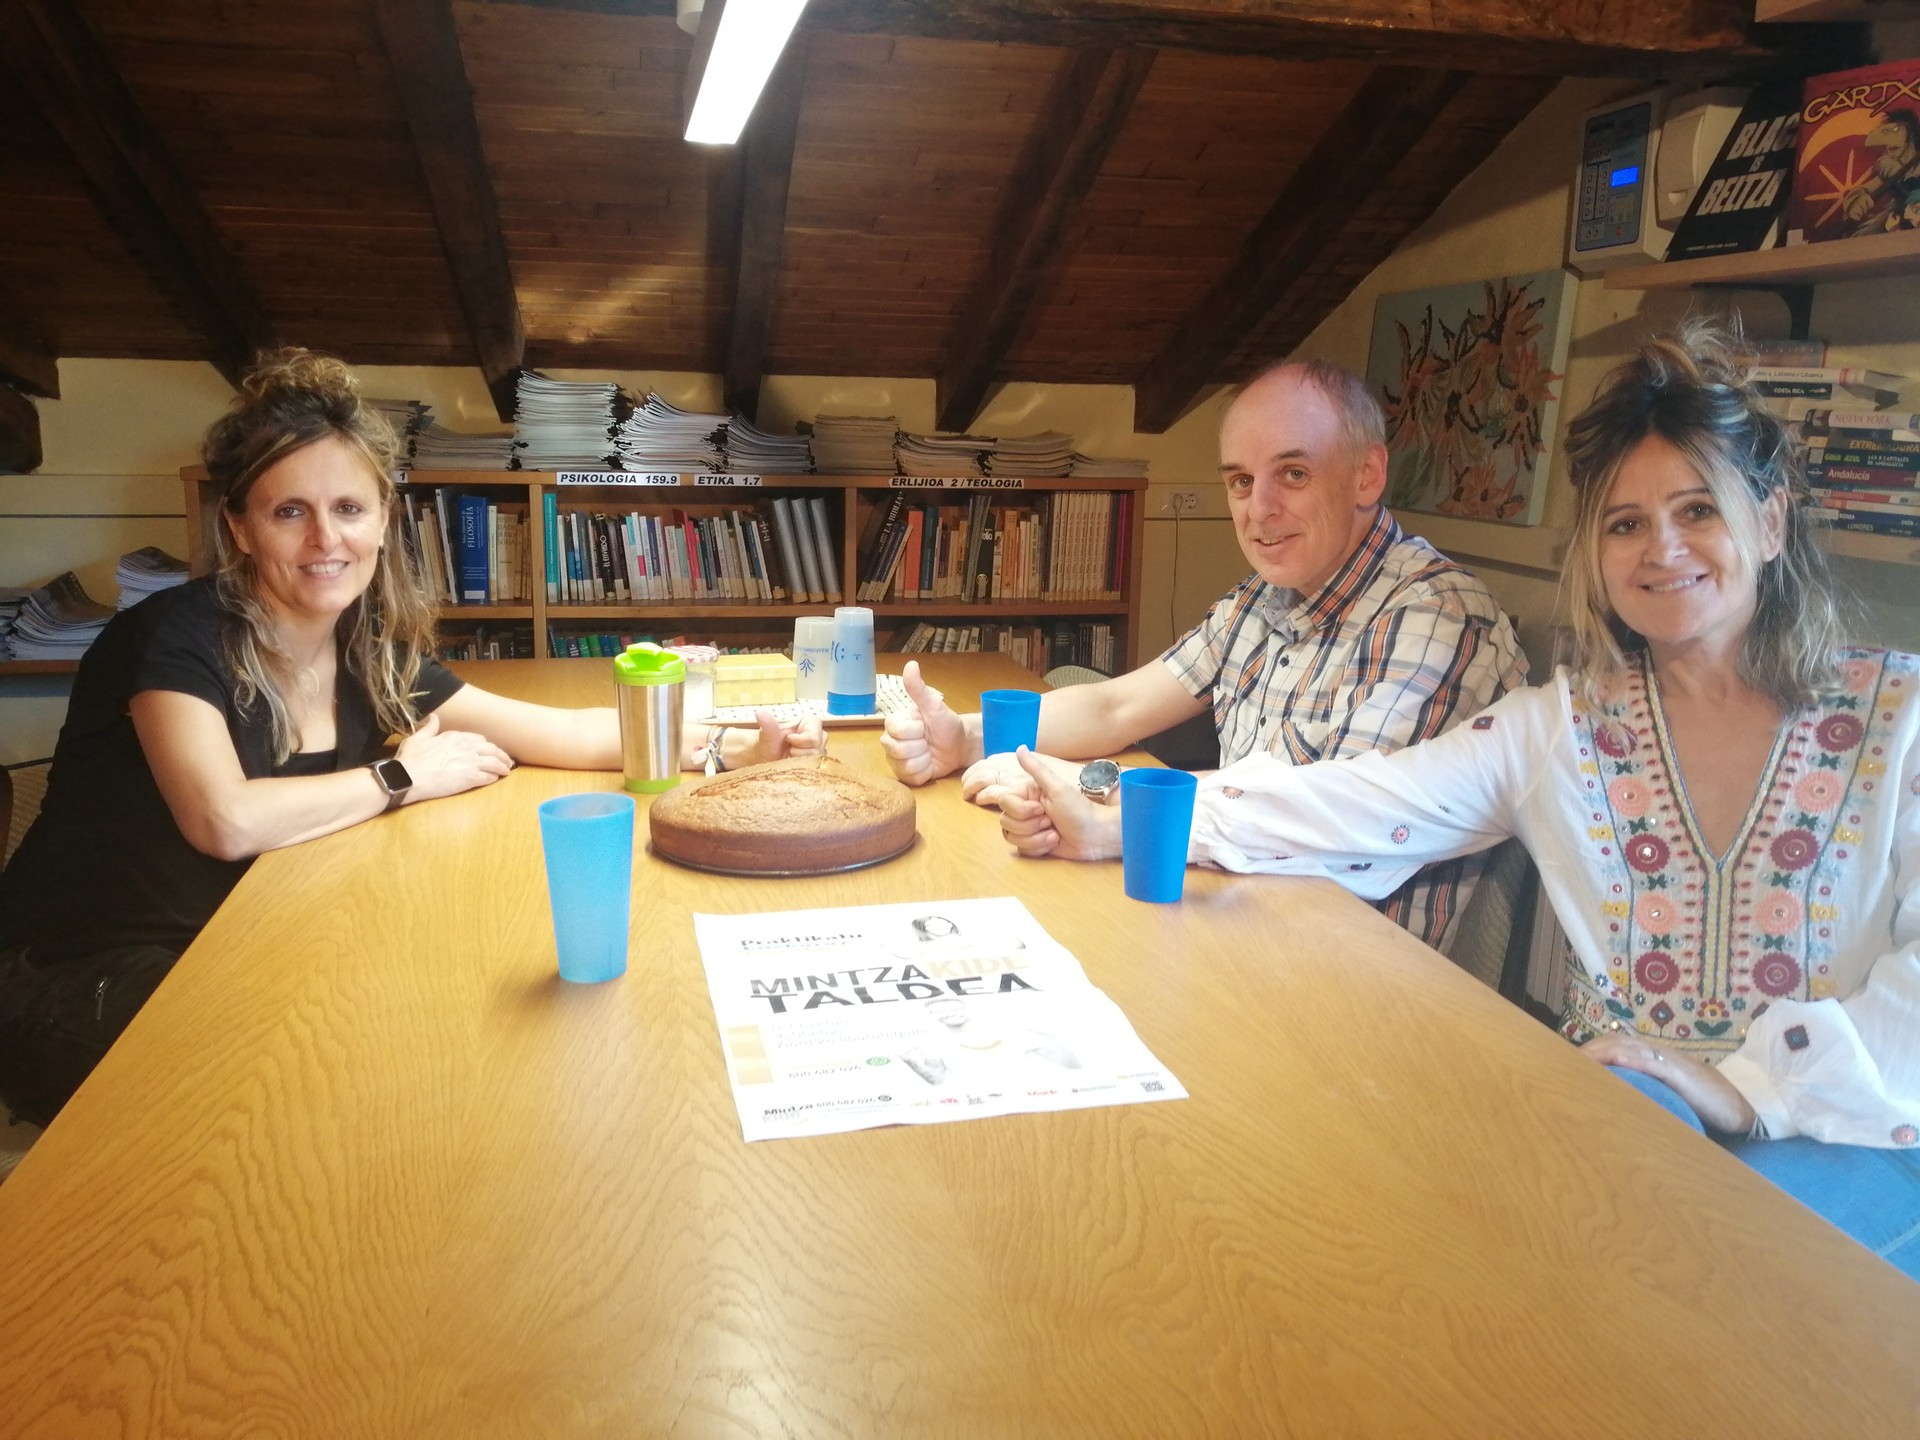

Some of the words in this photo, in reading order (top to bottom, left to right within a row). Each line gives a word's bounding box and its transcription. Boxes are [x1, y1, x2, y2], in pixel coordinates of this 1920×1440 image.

[1803, 78, 1920, 123] GARTX
[1695, 168, 1788, 216] BELTZA
[1834, 414, 1864, 425] NUEVA
[1865, 415, 1892, 426] YORK
[560, 474, 637, 484] PSIKOLOGIA
[645, 475, 678, 485] 159.9
[697, 476, 735, 485] ETIKA
[742, 476, 761, 486] 1.7
[1828, 468, 1870, 481] Andalucía
[891, 478, 944, 487] ERLIJIOA
[888, 495, 904, 522] BIBLIA
[750, 972, 1045, 1014] TALDEA
